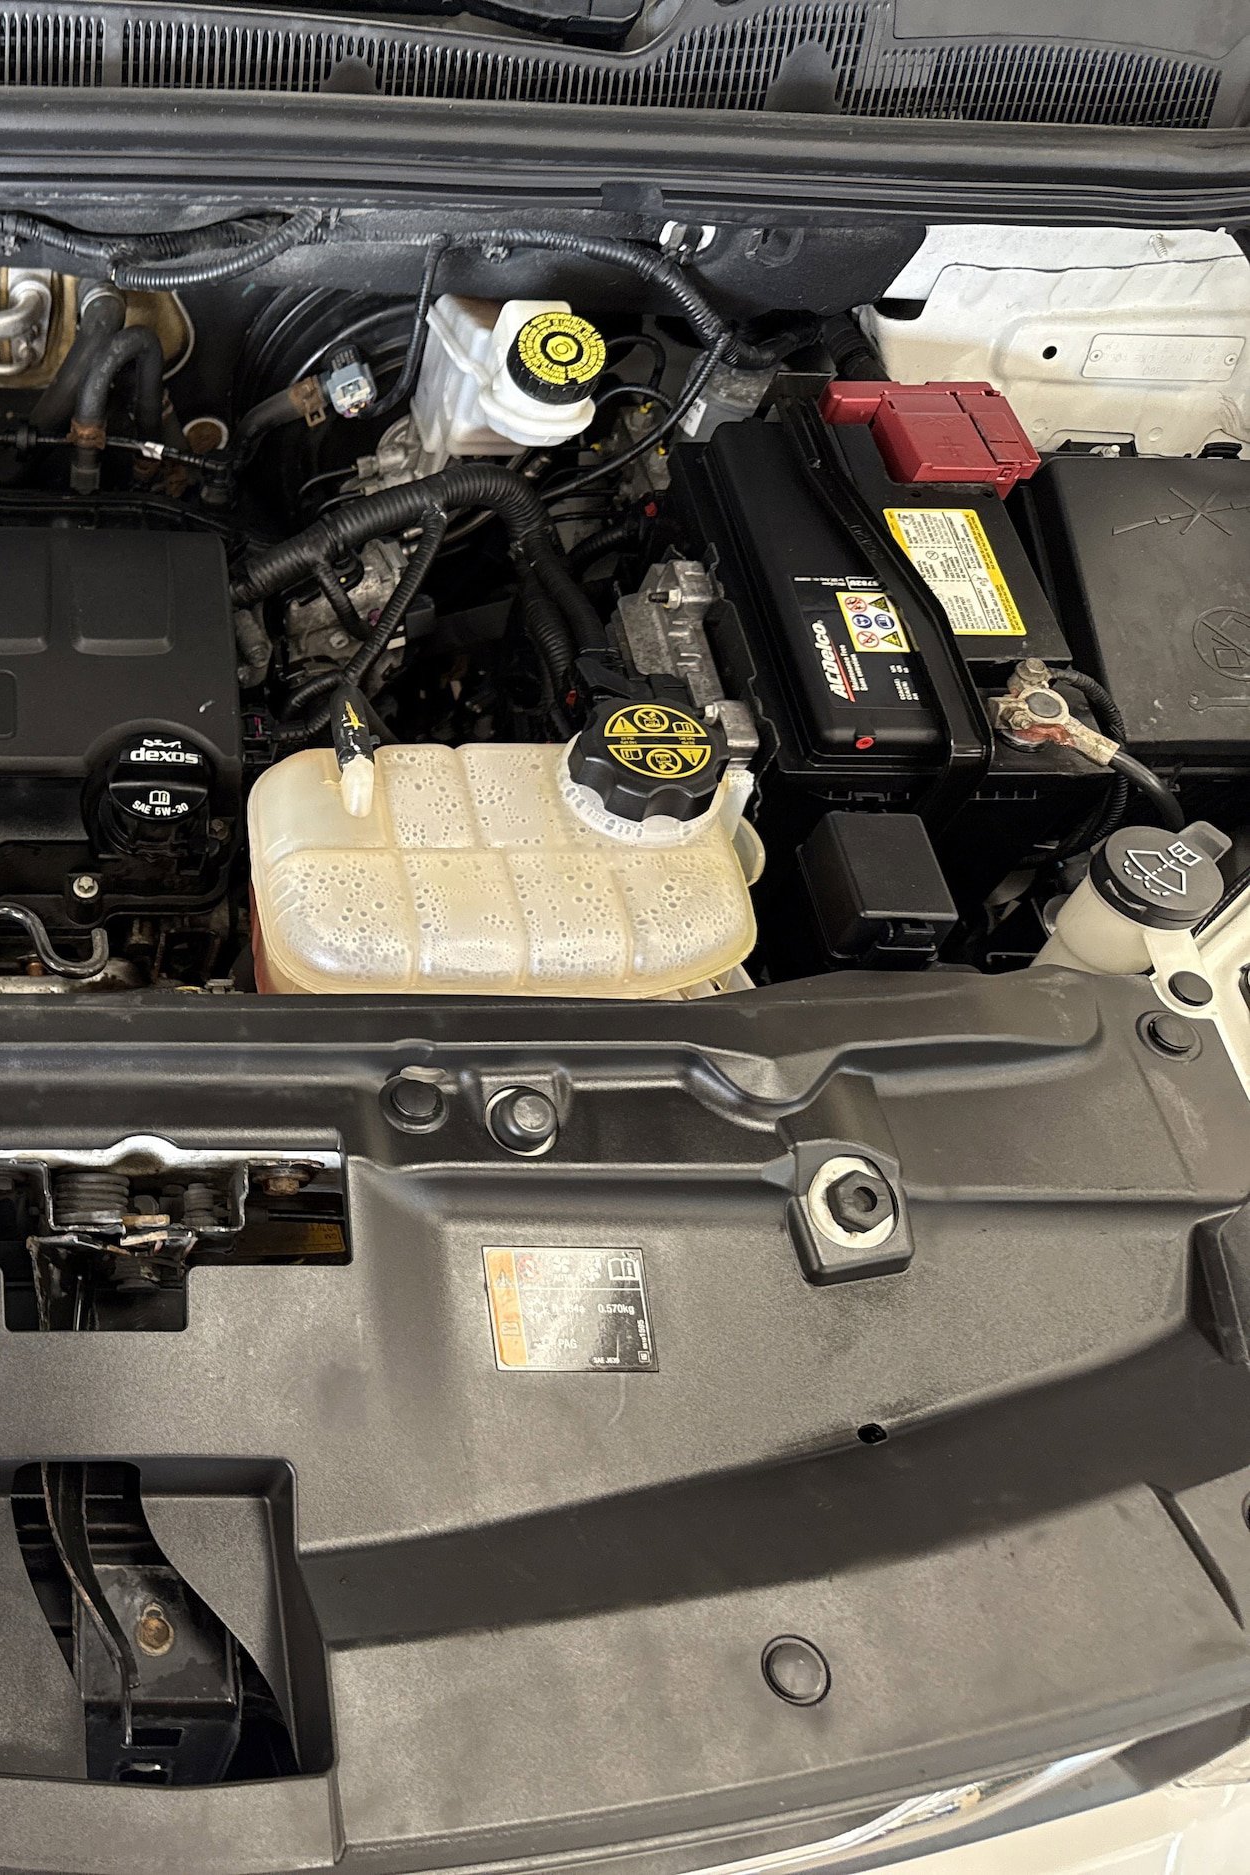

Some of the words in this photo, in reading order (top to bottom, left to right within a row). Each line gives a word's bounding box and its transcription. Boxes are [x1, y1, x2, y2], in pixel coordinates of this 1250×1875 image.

[811, 623, 848, 700] ACDelco
[130, 747, 199, 765] dexos
[132, 800, 152, 815] SAE
[154, 802, 189, 816] 5W-30
[597, 1303, 635, 1315] 0.570kg
[558, 1338, 578, 1349] PAG
